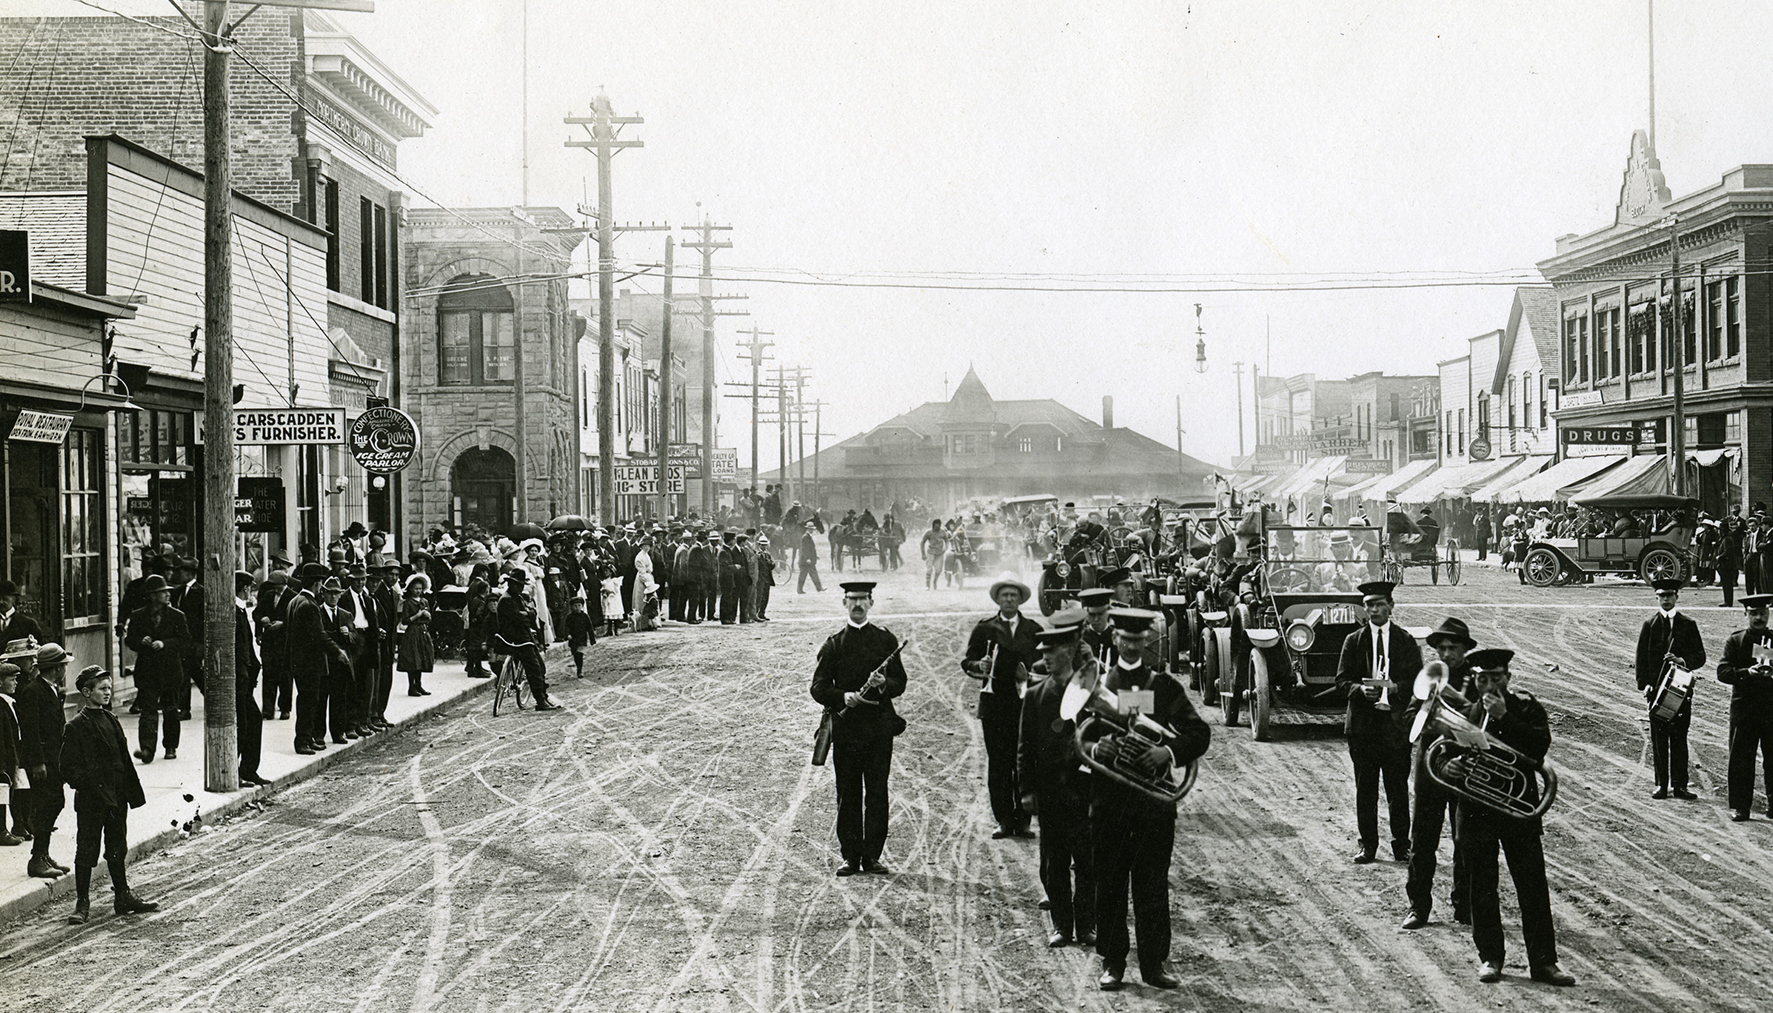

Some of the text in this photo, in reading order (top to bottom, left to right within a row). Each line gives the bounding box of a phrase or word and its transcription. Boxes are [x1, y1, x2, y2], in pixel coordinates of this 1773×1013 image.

[352, 124, 372, 153] CROWN
[16, 412, 75, 432] ROYAL RESTAURANT
[237, 413, 335, 426] CARSCADDEN
[252, 427, 341, 440] FURNISHER.
[1568, 430, 1634, 441] DRUGS
[353, 427, 414, 454] THE CROWN
[1310, 438, 1368, 451] BARBER
[356, 451, 410, 460] ICE CREAM
[1321, 447, 1355, 457] SHOP
[711, 460, 734, 468] TATE
[653, 467, 682, 480] BOS.
[253, 486, 268, 497] THE
[255, 500, 277, 510] ATER
